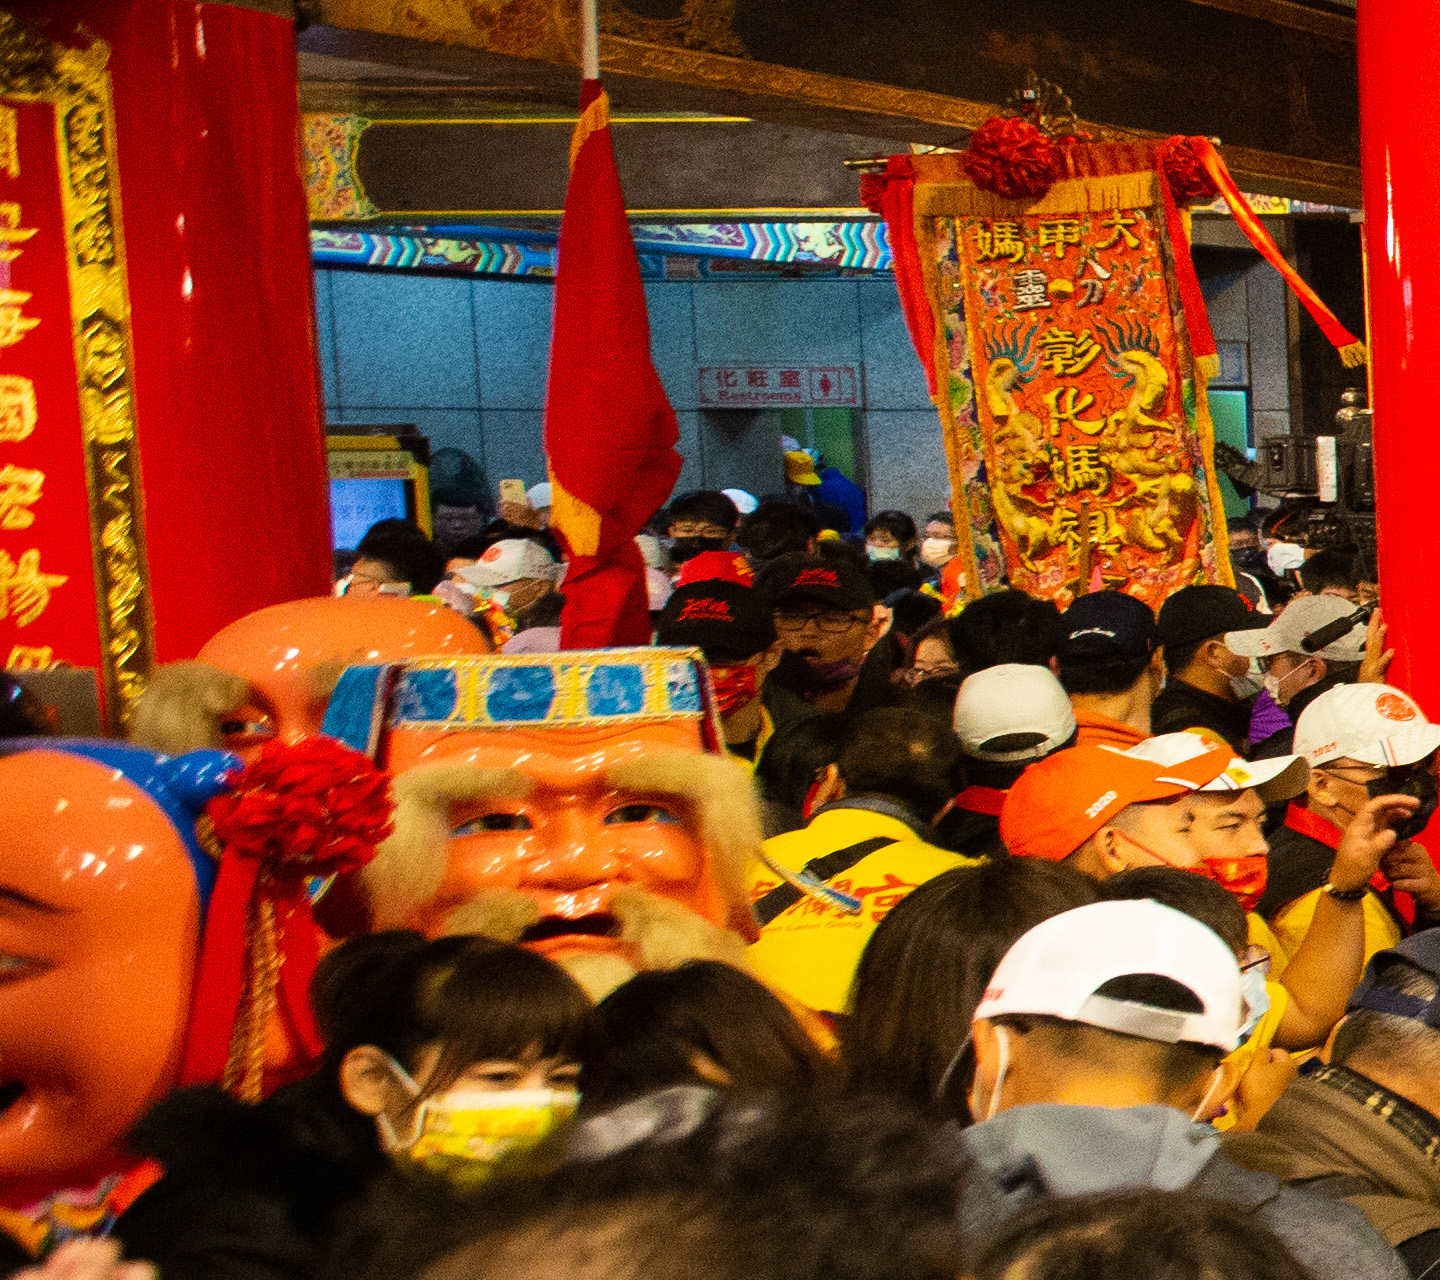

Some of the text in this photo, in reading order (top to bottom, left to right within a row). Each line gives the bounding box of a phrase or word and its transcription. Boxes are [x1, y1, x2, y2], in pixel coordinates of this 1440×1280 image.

[972, 209, 1141, 263] 大甲媽
[1085, 790, 1117, 818] 2020
